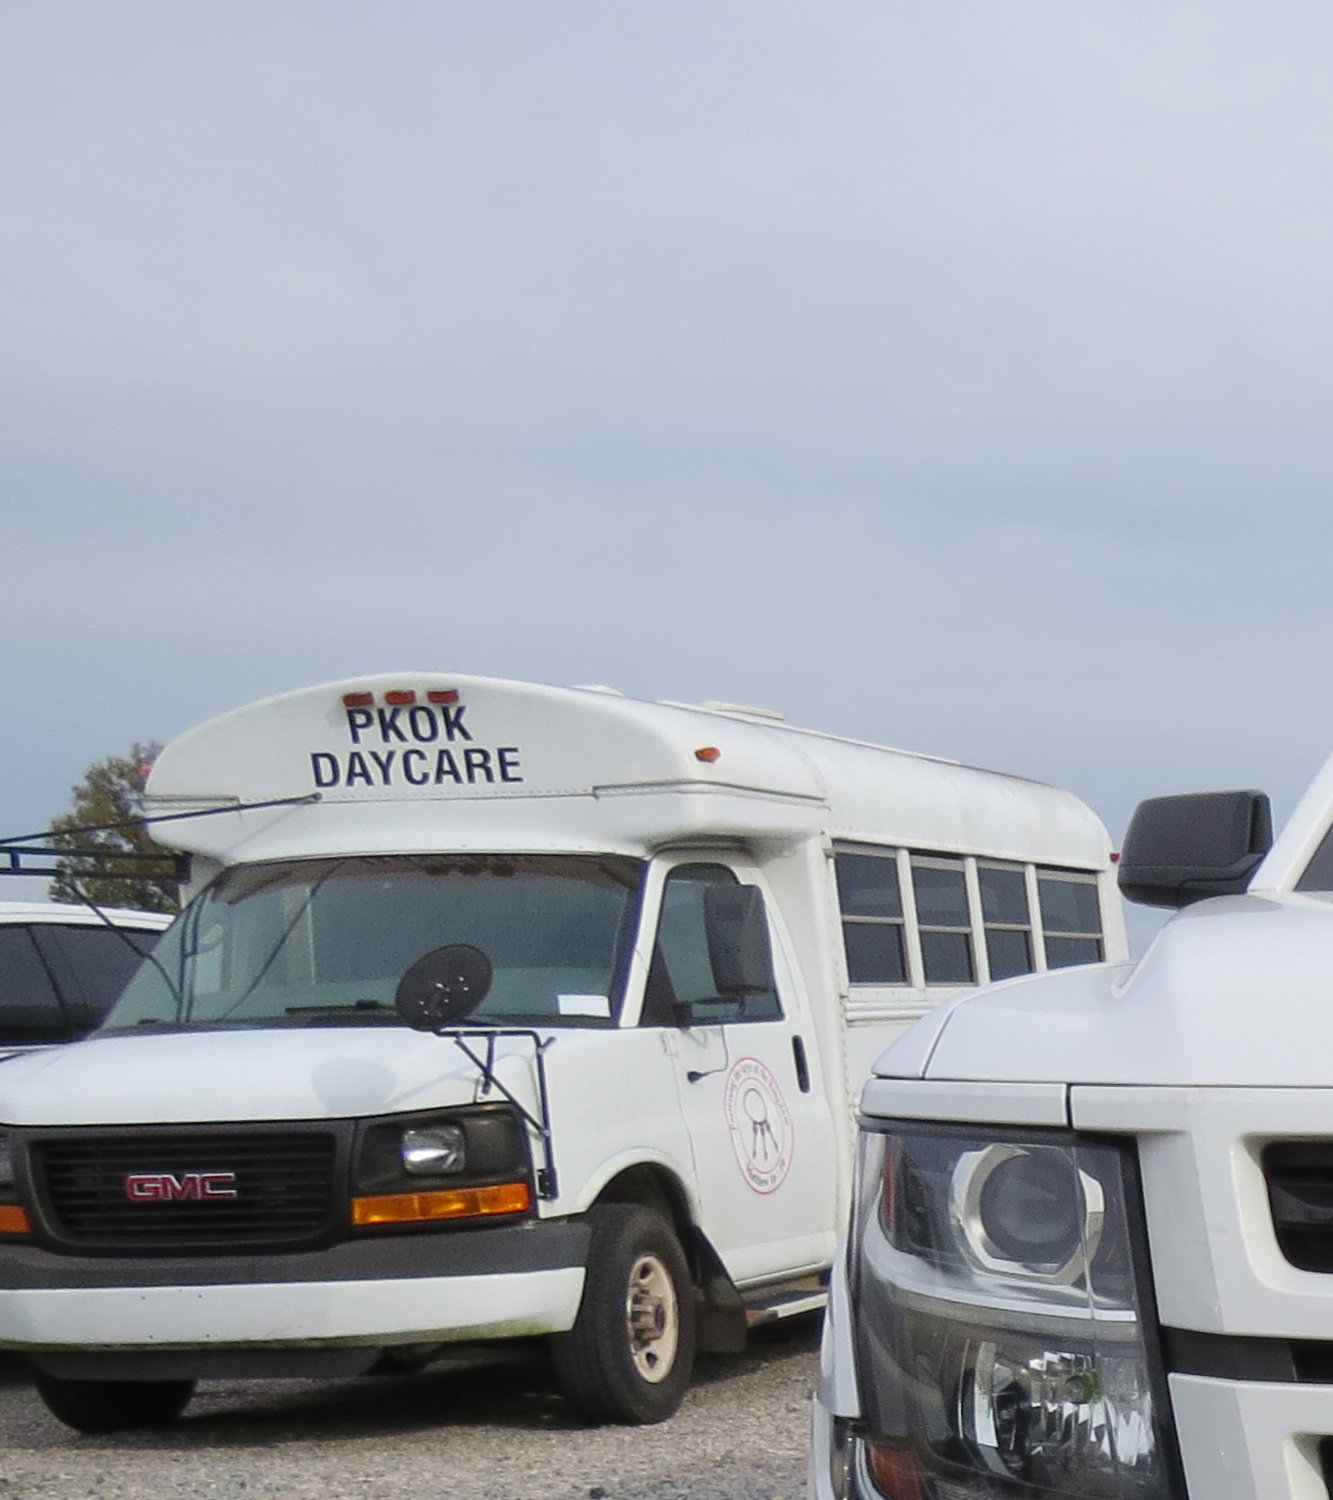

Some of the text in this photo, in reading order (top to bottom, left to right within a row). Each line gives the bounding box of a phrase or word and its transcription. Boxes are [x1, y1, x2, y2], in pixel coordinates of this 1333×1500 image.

[346, 705, 474, 744] PKOK
[311, 747, 524, 788] DAYCARE
[126, 1172, 238, 1201] GMC
